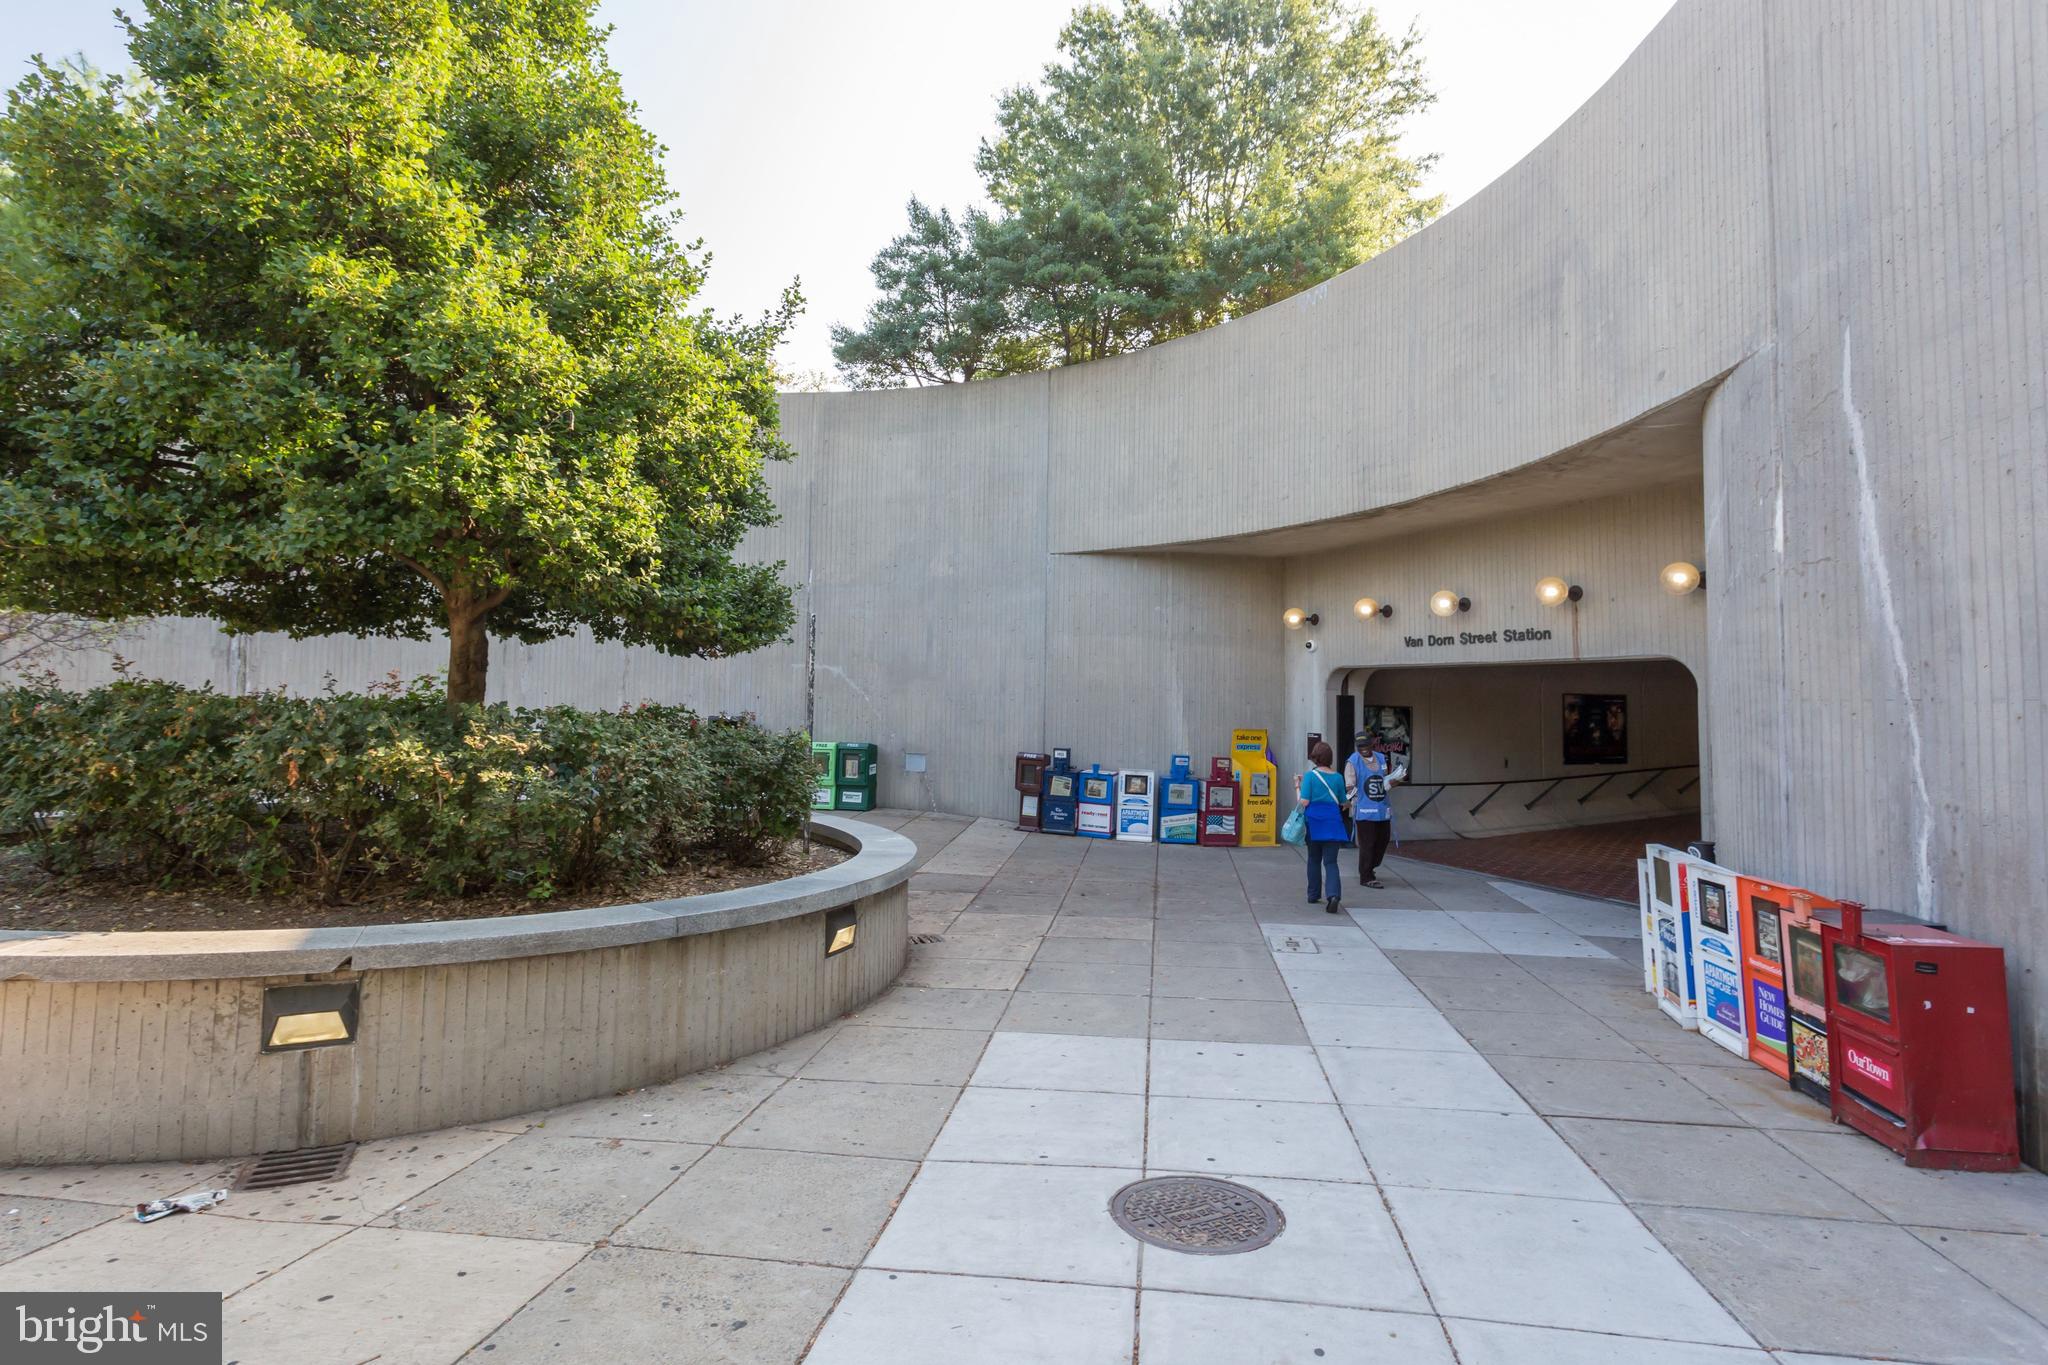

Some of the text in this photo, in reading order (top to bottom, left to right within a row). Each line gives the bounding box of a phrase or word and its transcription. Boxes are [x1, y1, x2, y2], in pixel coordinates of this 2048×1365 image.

[1404, 628, 1552, 648] Van Dorn Street Station
[1705, 962, 1737, 988] APARTMENT
[1758, 986, 1776, 1003] NEW
[1759, 999, 1785, 1020] HOMES
